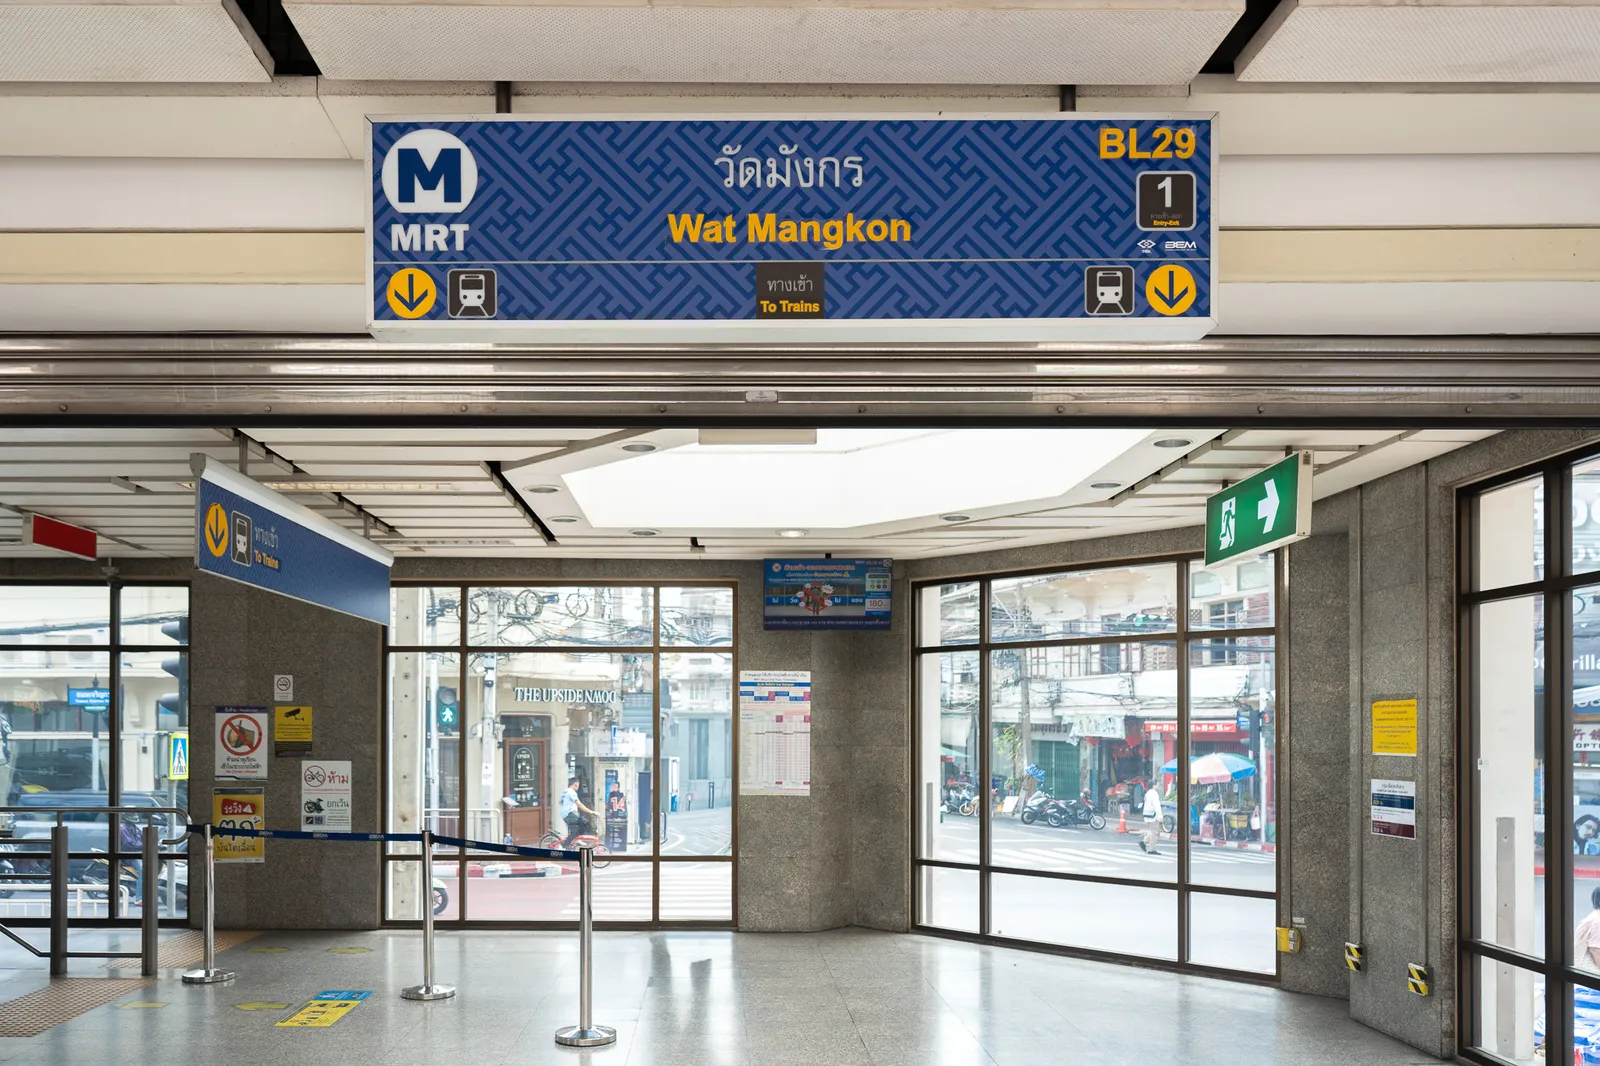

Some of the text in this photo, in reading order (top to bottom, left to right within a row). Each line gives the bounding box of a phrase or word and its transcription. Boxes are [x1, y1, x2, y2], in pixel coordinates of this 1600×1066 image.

[1099, 127, 1196, 159] BL29
[714, 144, 864, 188] วัดมังกร
[1157, 176, 1172, 208] 1
[391, 223, 470, 252] MRT
[667, 212, 911, 250] Wat Mangkon
[1165, 241, 1197, 249] BEM
[766, 274, 814, 292] ทางเข้า
[760, 299, 820, 312] To Trains
[254, 526, 279, 549] ทางเข้า
[254, 549, 279, 569] To Trains
[514, 687, 540, 702] THE
[540, 688, 584, 703] UPSIDE
[327, 770, 349, 784] ห้าม
[327, 798, 349, 808] ยกเว้น
[611, 797, 626, 811] 14
